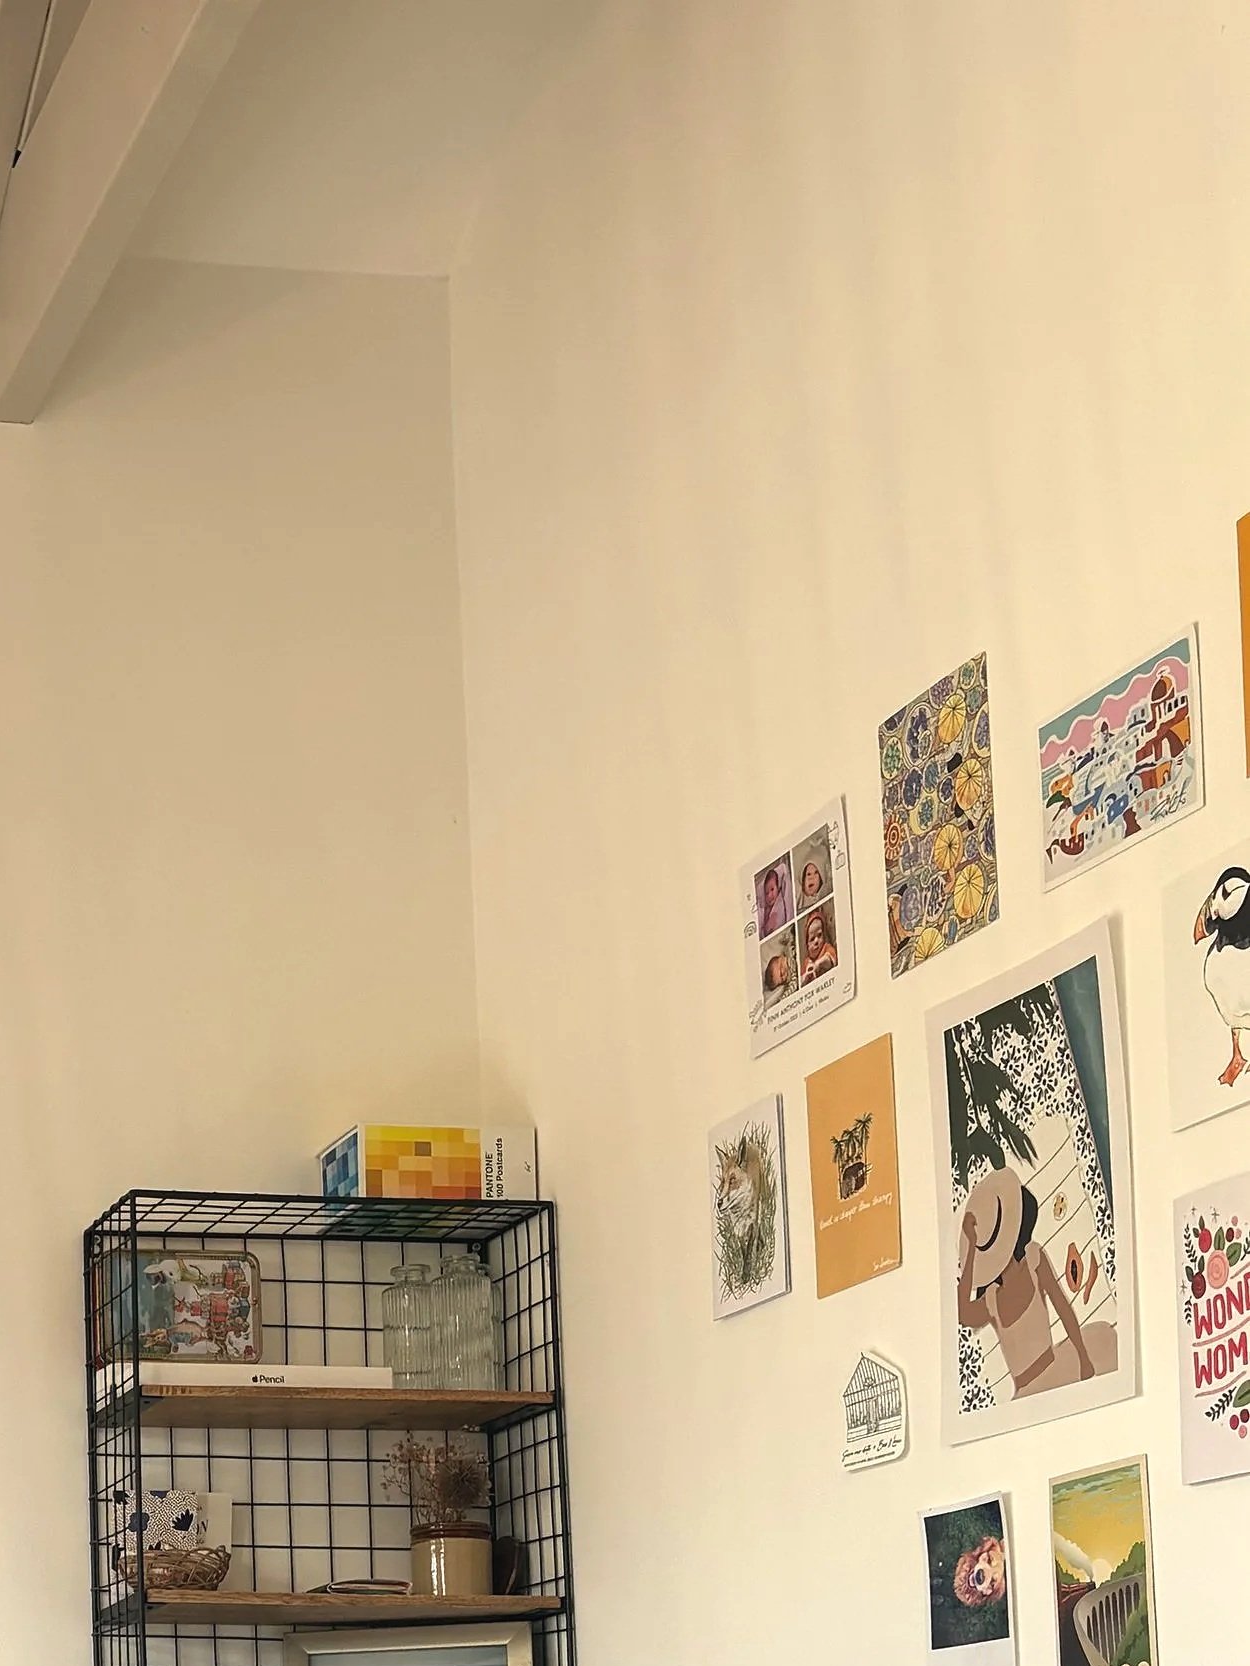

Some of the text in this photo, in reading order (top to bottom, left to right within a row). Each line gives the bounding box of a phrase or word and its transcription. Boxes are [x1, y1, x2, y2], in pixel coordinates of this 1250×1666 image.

[485, 1153, 494, 1198] PANTONE
[496, 1137, 504, 1182] Postcards
[259, 1375, 285, 1384] Pencil
[1193, 1331, 1249, 1389] WOM
